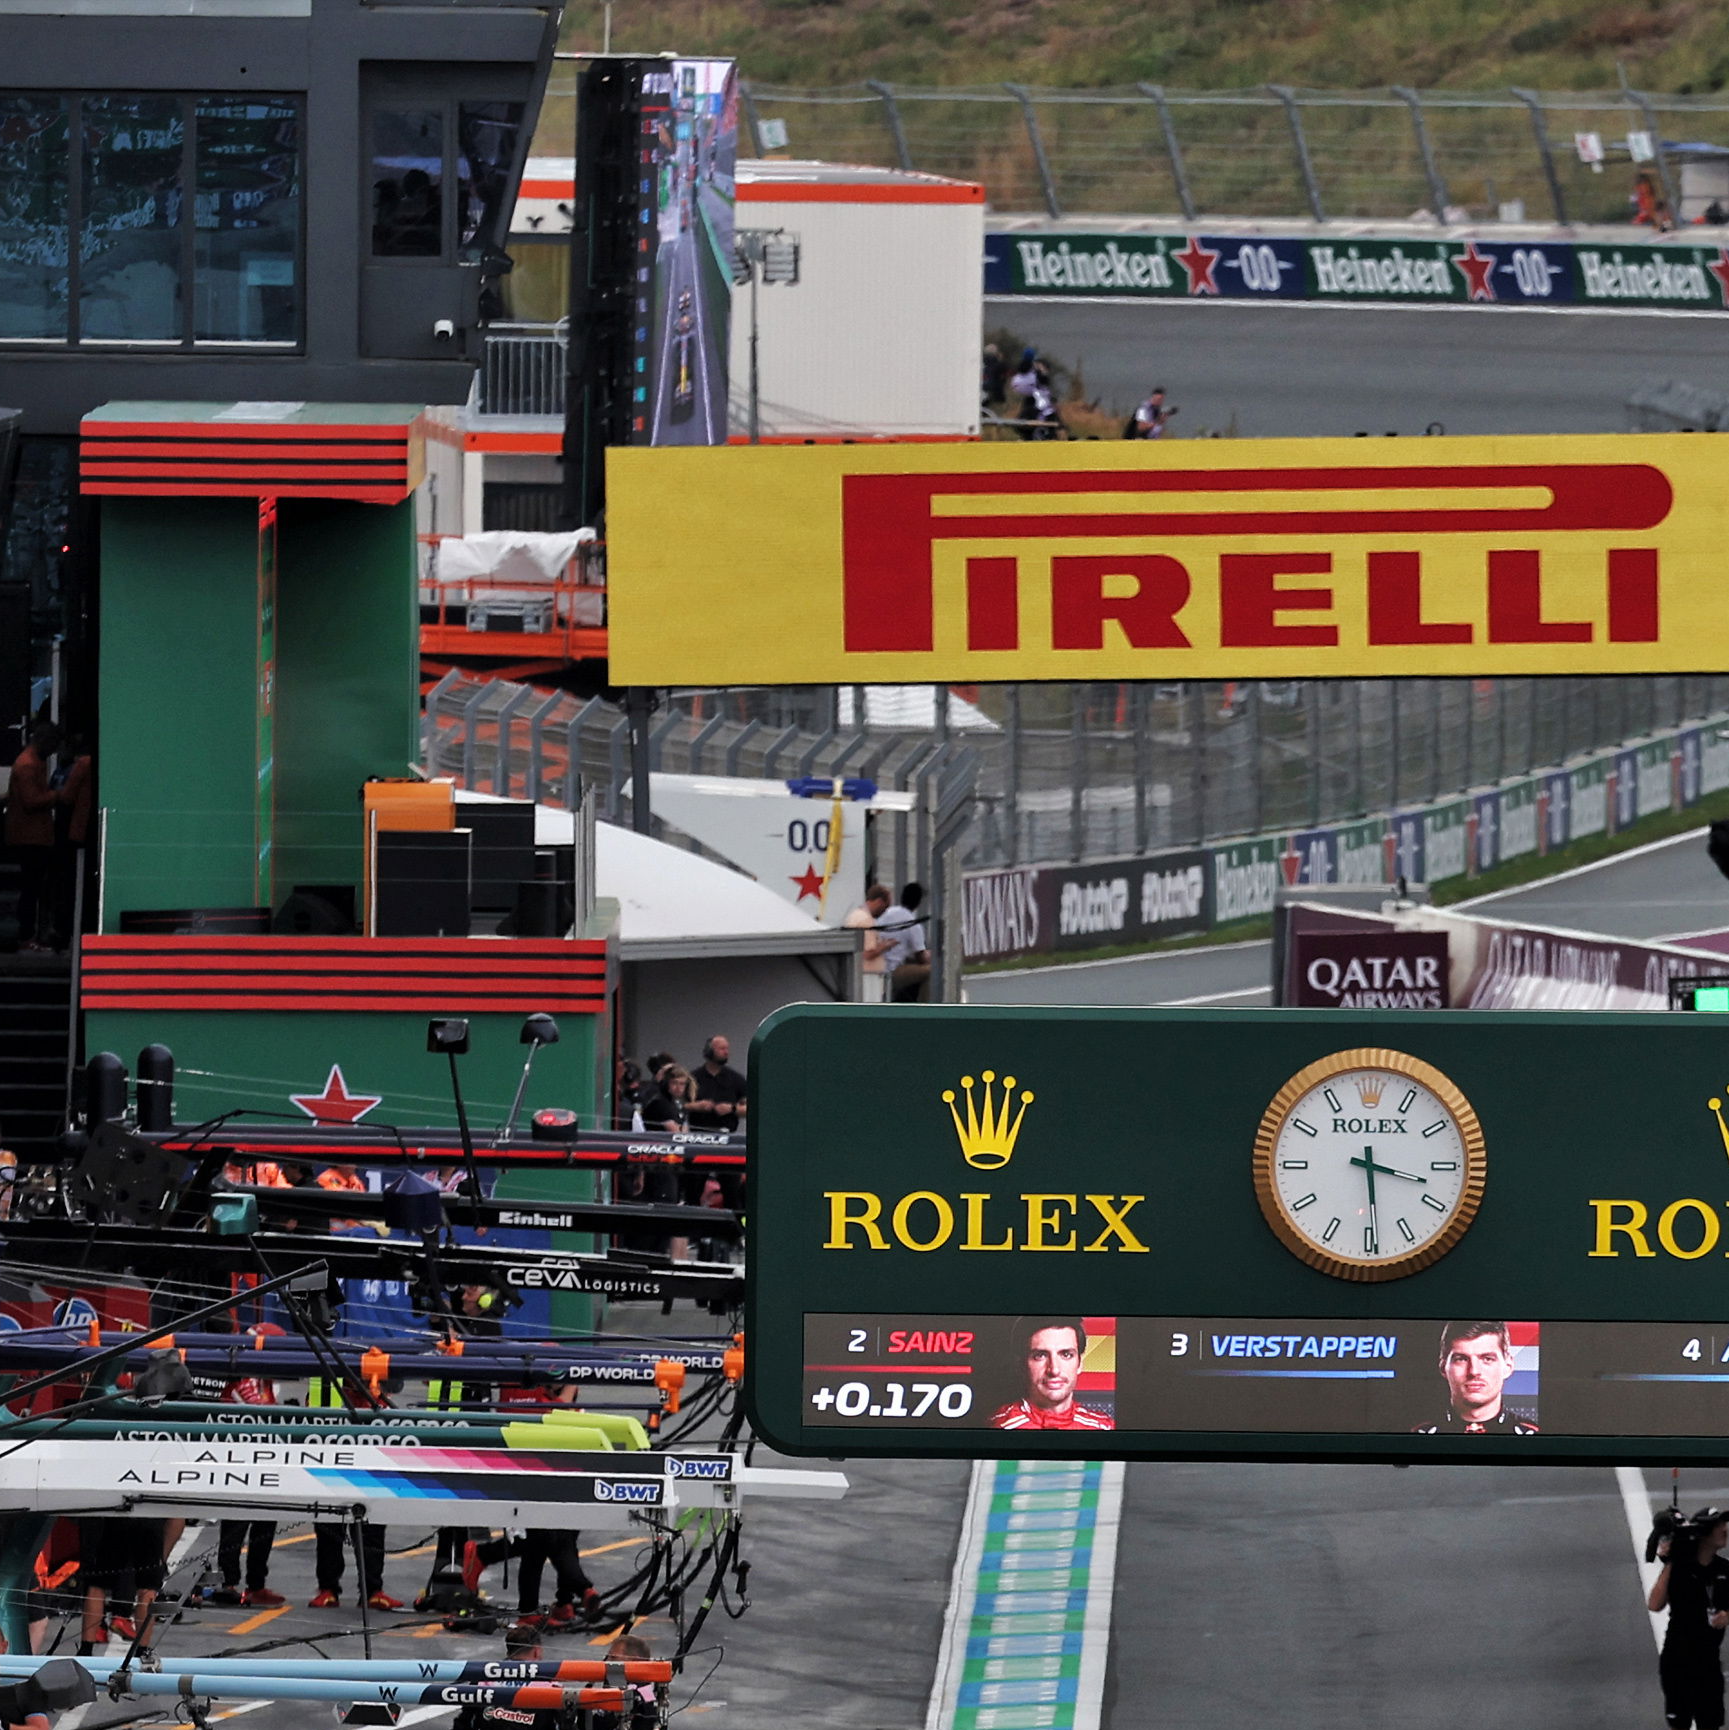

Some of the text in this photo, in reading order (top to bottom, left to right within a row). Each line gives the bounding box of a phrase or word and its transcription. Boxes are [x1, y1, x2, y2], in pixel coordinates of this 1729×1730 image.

[1017, 240, 1172, 288] Heineken
[1310, 246, 1453, 294] Heineken
[1579, 250, 1712, 299] Heineken
[843, 464, 1674, 653] PIRELLI
[1308, 955, 1440, 993] QATAR
[1333, 1117, 1407, 1134] ROLEX
[673, 1133, 729, 1144] ORACLE
[628, 1145, 684, 1155] ORACLE
[823, 1190, 1150, 1253] ROLEX
[585, 1278, 660, 1295] LOGISTICS
[848, 1329, 974, 1354] 2 SAINZ
[1170, 1333, 1396, 1360] 3 VERSTAPPEN
[1682, 1338, 1702, 1361] 4
[570, 1366, 655, 1381] DP WORLD
[811, 1382, 973, 1418] +0.170
[195, 1451, 355, 1466] ALPINE
[683, 1459, 727, 1478] BWT
[118, 1470, 280, 1486] ALPINE
[613, 1484, 658, 1501] BWT
[485, 1662, 538, 1678] Gulf
[442, 1687, 495, 1703] Gulf
[494, 1707, 534, 1725] Castrol
